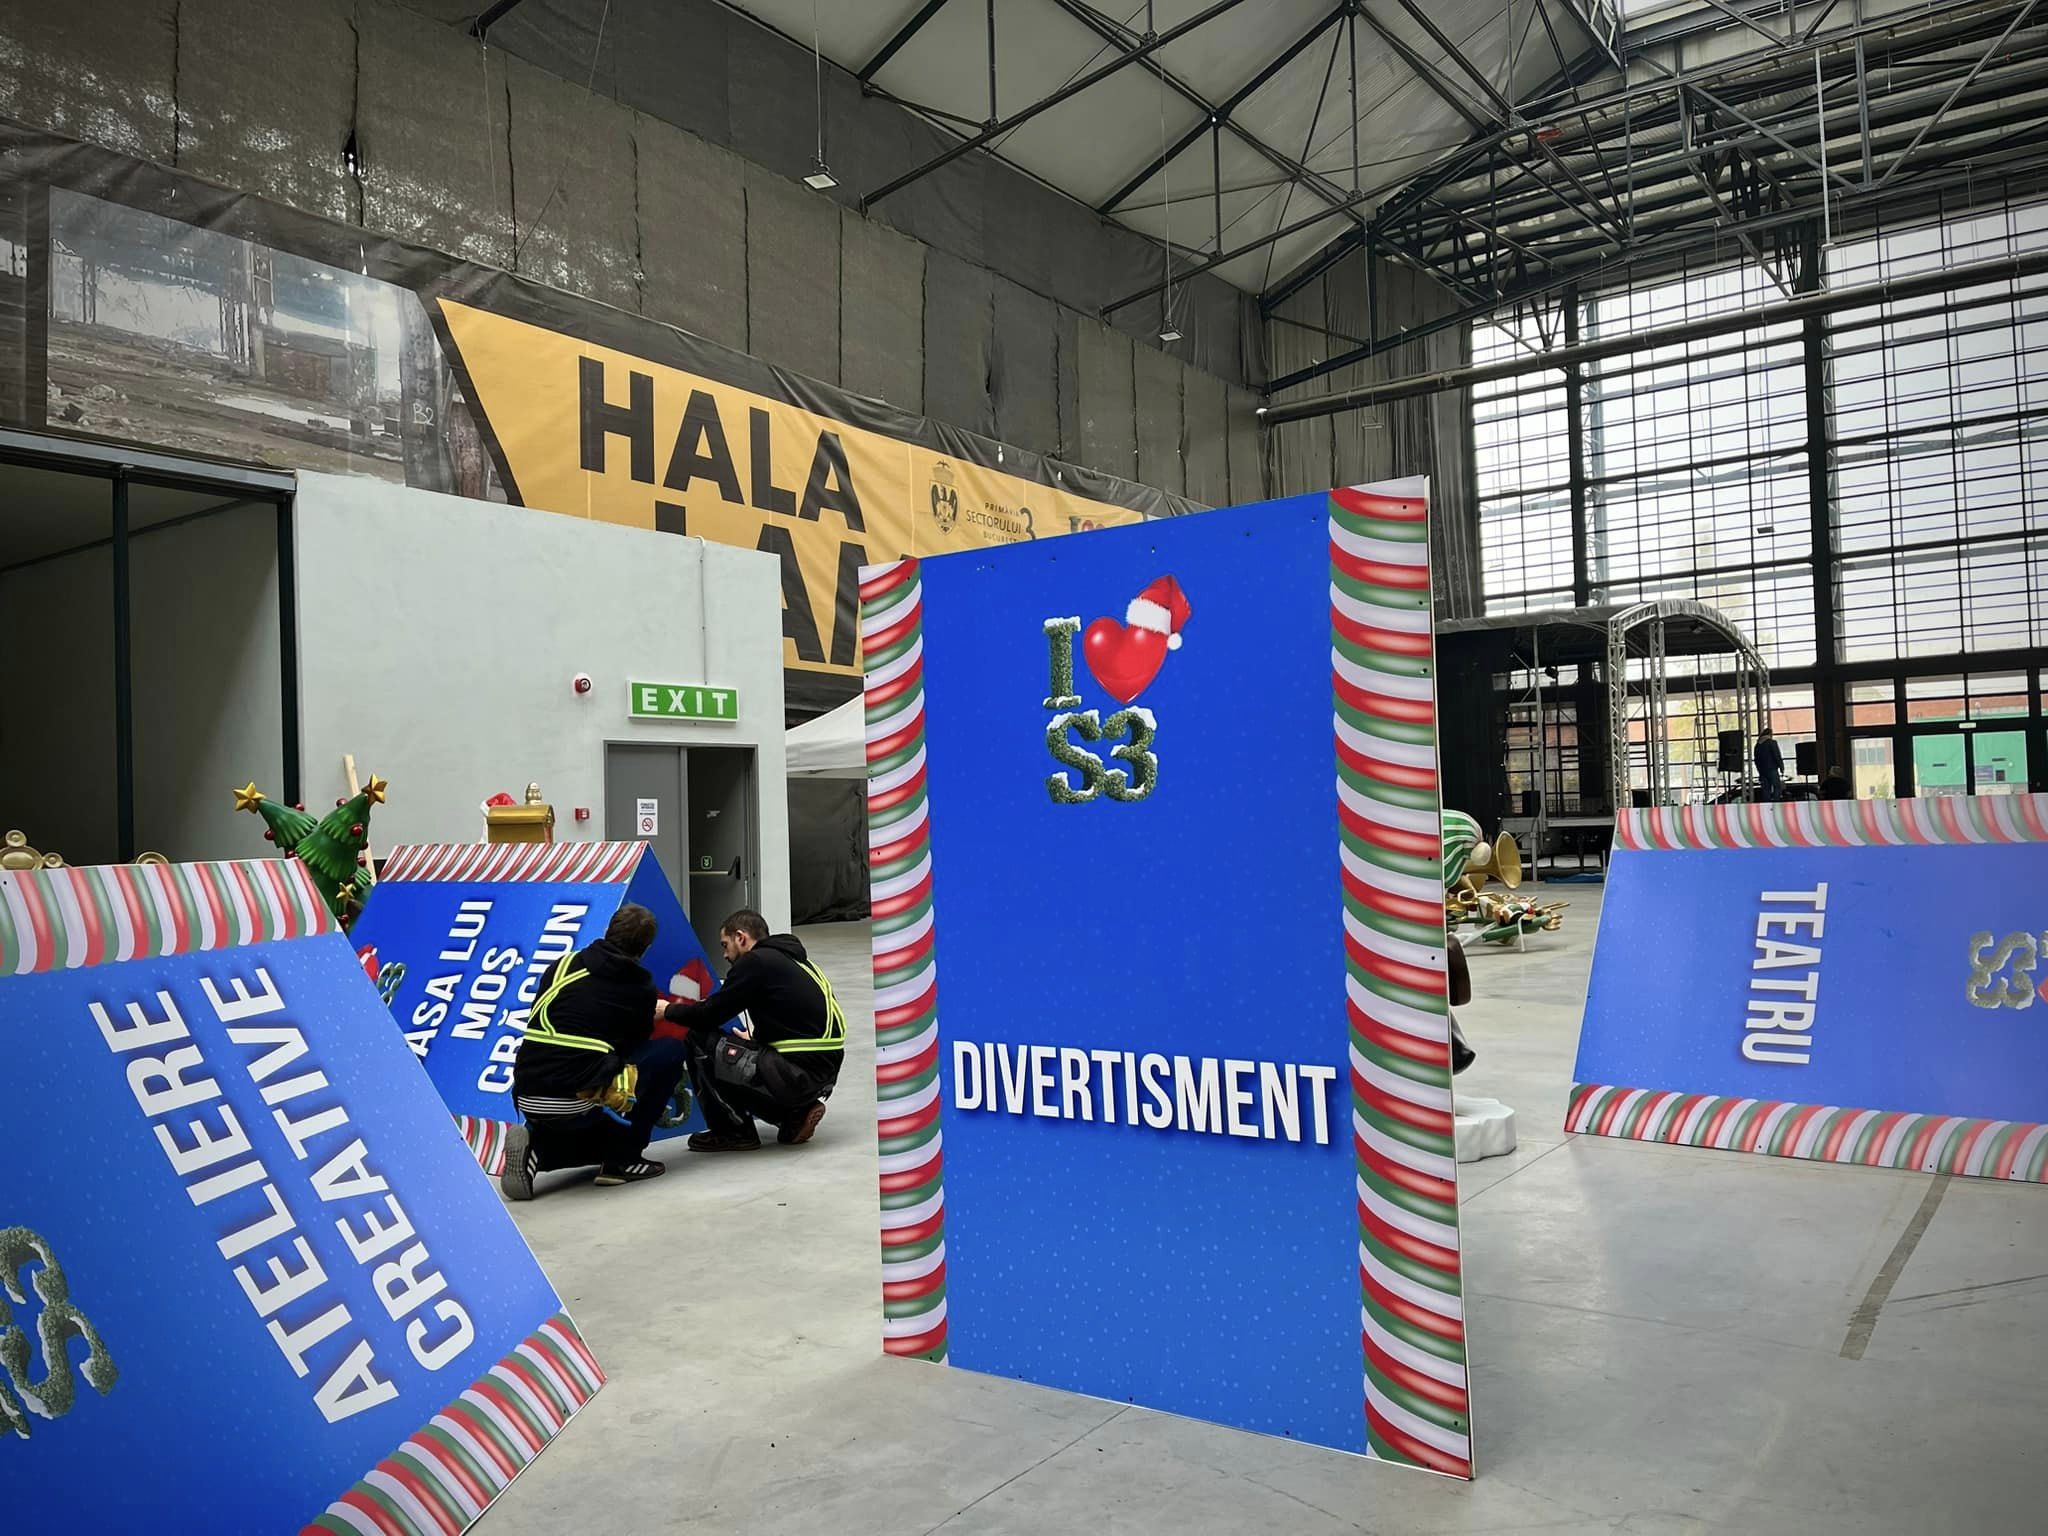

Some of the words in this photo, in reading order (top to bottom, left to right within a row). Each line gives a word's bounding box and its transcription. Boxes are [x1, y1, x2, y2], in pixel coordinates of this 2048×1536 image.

[413, 402, 435, 427] B2
[578, 355, 866, 534] HALA
[966, 509, 1021, 535] SECTORULUI
[641, 687, 729, 715] EXIT
[1043, 616, 1082, 710] I
[1046, 705, 1158, 805] S3
[406, 973, 464, 1058] ASA
[439, 901, 493, 961] LUI
[450, 947, 525, 1040] MOȘ
[1741, 882, 1829, 1065] TEATRU
[1966, 930, 2038, 1010] S3
[953, 1040, 1337, 1145] DIVERTISMENT
[87, 989, 400, 1424] ATELIERE
[200, 967, 475, 1372] CREATIVE
